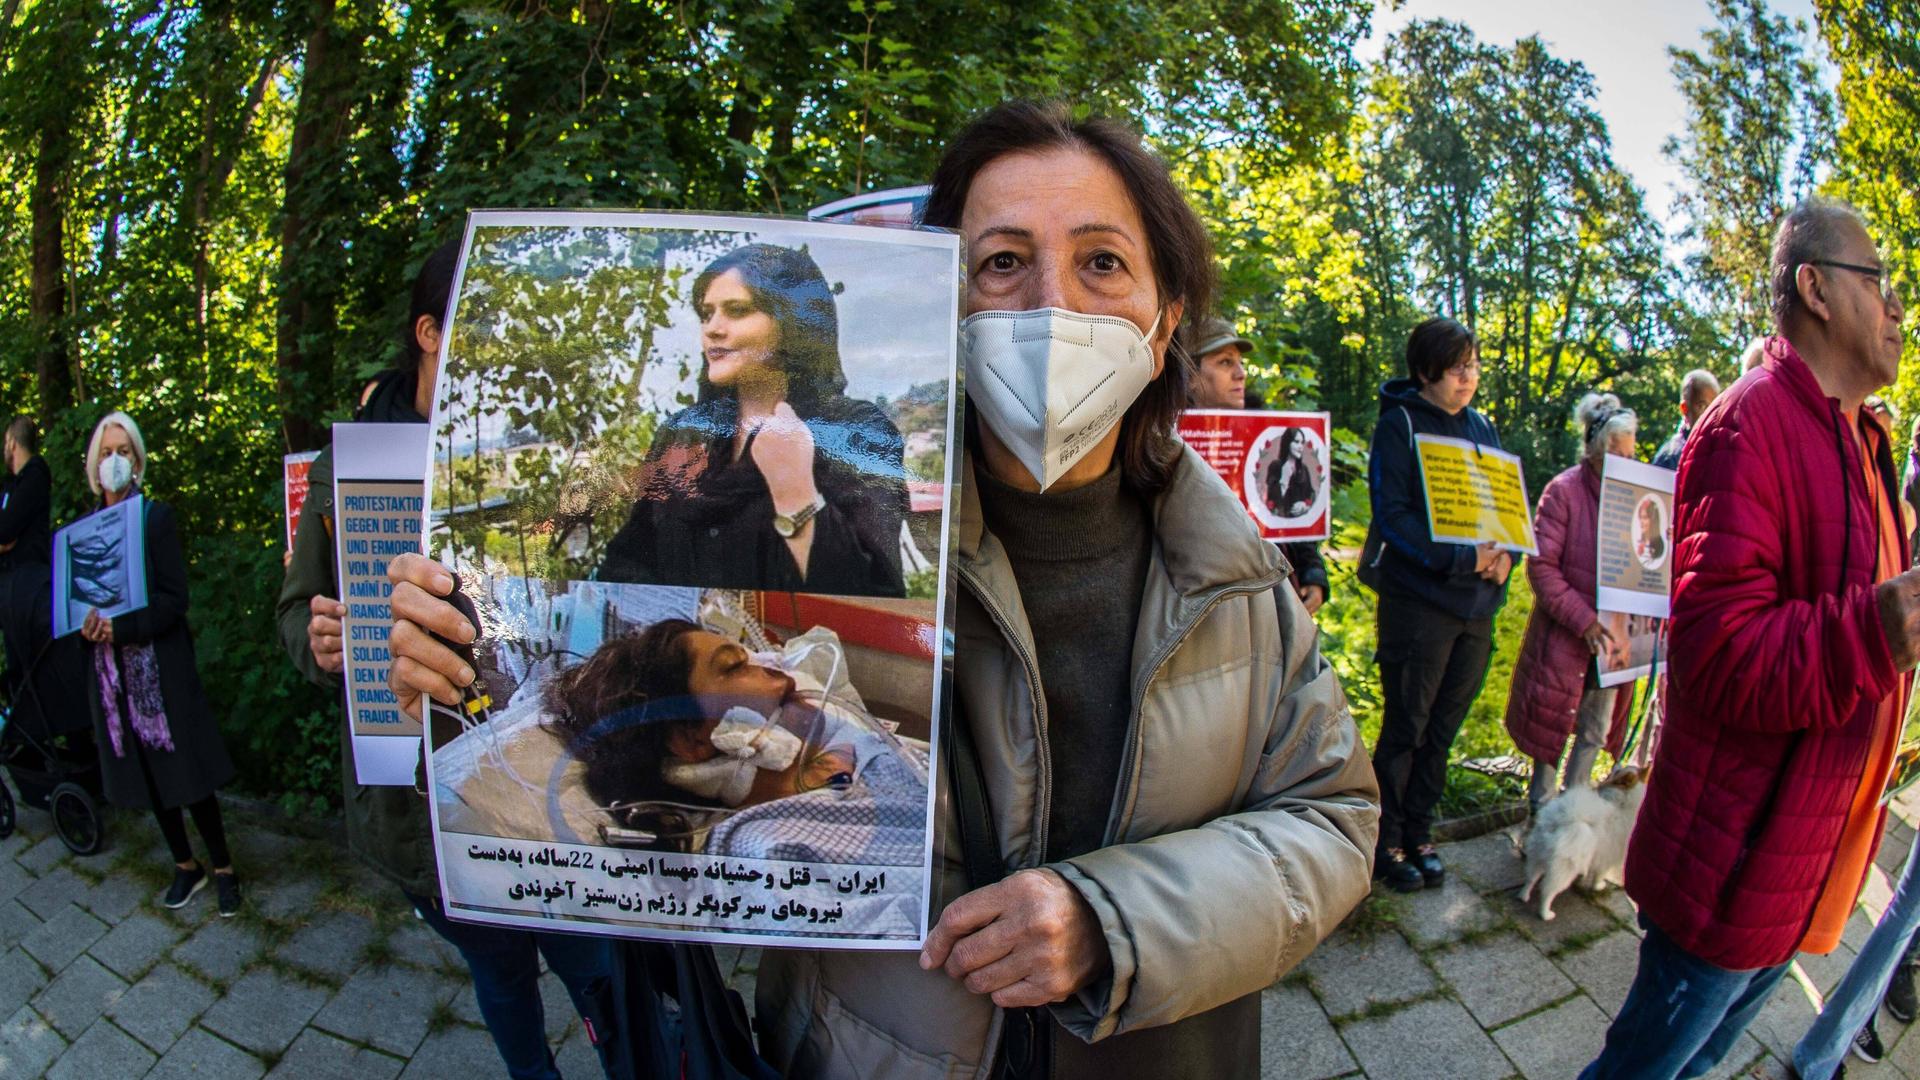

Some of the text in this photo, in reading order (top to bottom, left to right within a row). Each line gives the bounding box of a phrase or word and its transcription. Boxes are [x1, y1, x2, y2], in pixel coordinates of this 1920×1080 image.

[1059, 446, 1080, 465] FFP2
[345, 517, 380, 533] GEGEN
[382, 518, 400, 534] DIE
[346, 538, 369, 555] UND
[347, 560, 369, 576] VON
[354, 668, 375, 682] DEN
[358, 709, 403, 724] FRAUEN.
[600, 857, 654, 879] امینی،
[659, 858, 699, 881] مهسا
[704, 861, 775, 889] وحشیانه
[780, 867, 811, 890] قتل
[508, 879, 576, 903] آخوندی
[837, 871, 885, 895] ایران
[648, 892, 687, 916] رژیم
[771, 899, 843, 923] نیروهای
